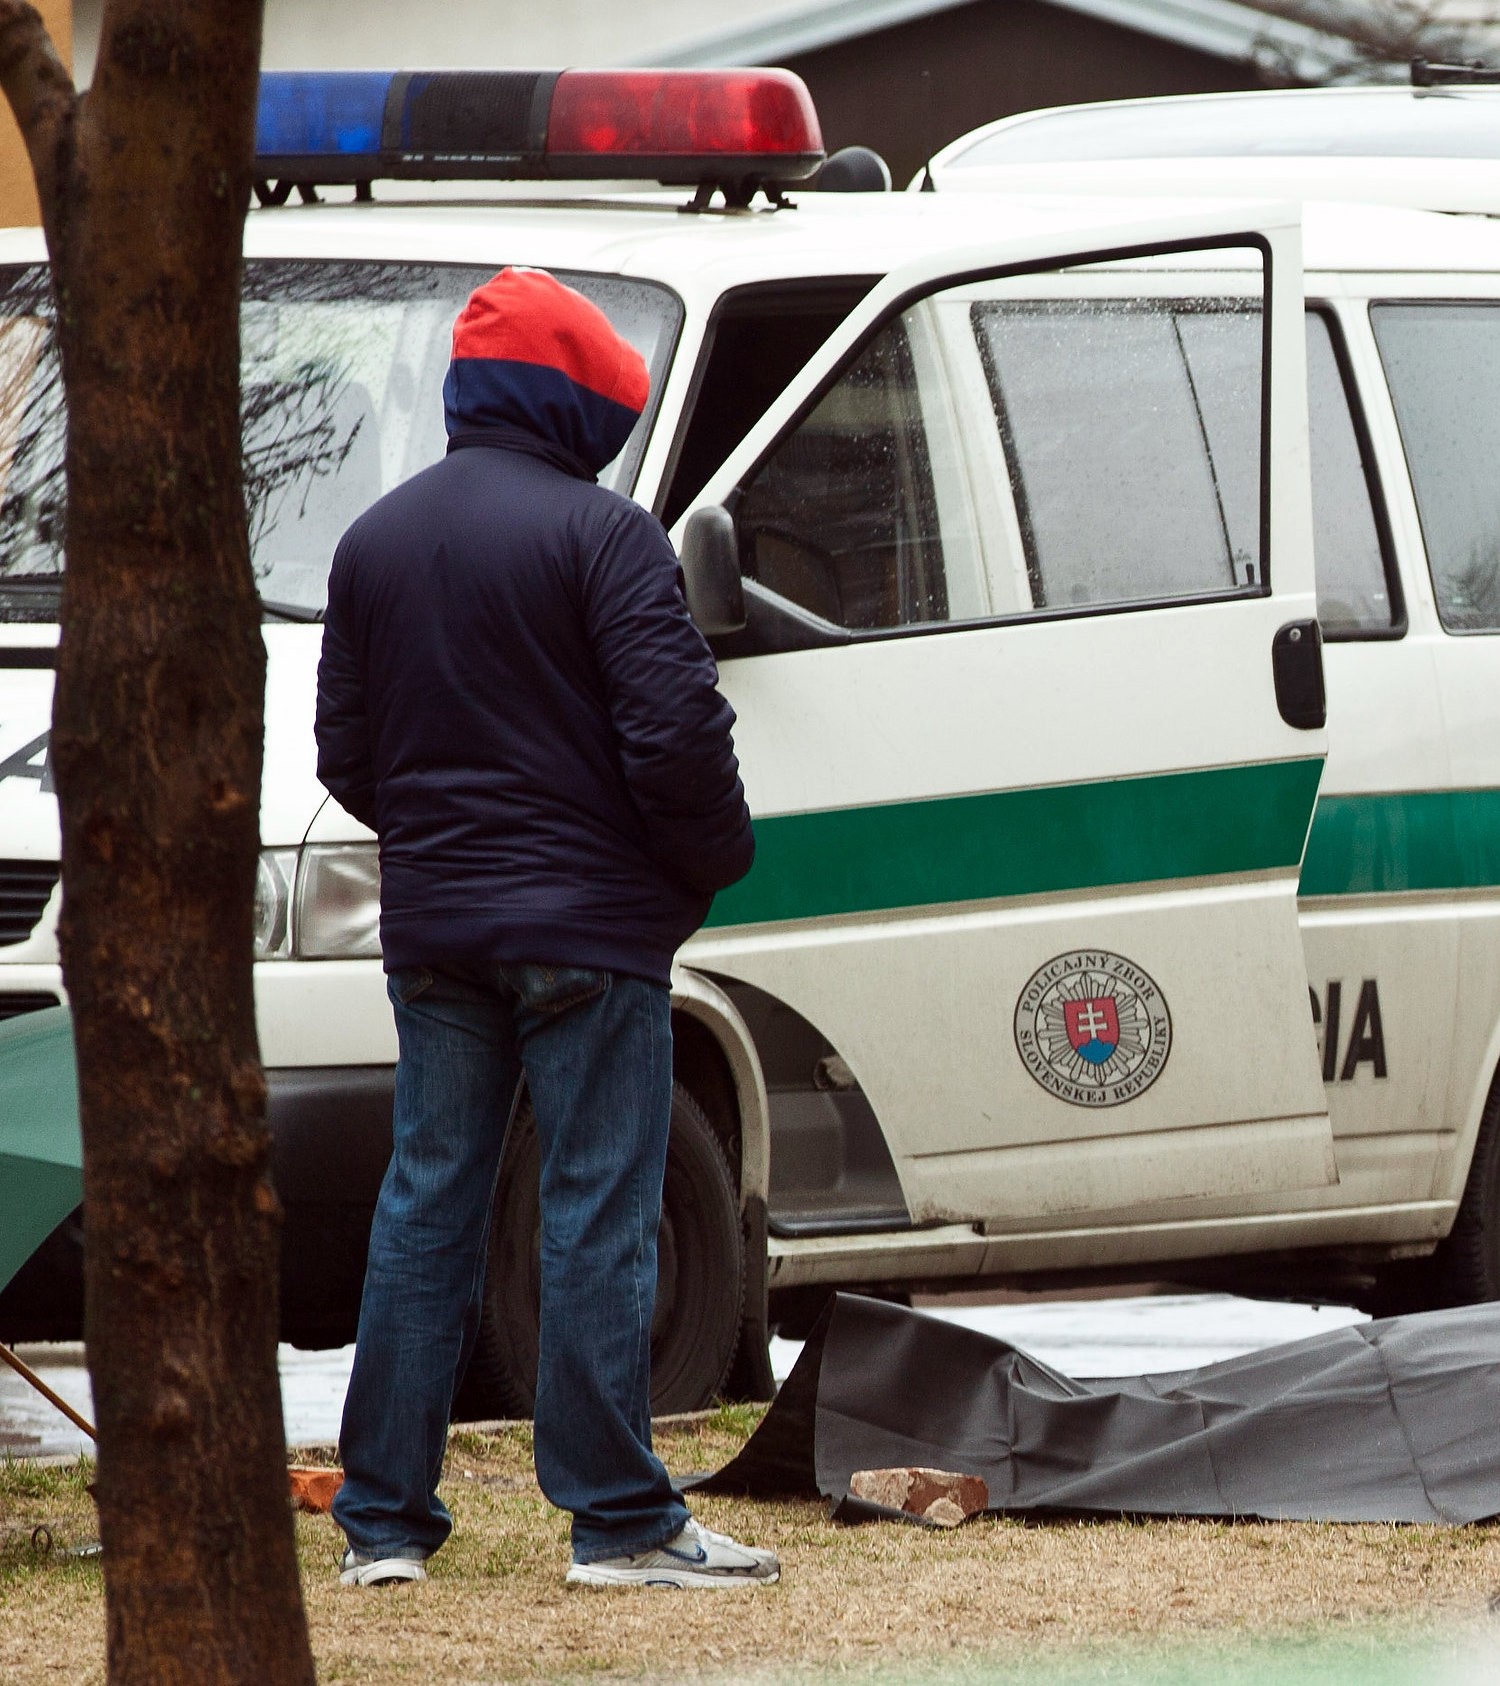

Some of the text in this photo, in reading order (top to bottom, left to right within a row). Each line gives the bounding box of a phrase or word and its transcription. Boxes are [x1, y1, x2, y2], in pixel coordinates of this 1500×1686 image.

[1113, 960, 1154, 1000] ZBOR
[1020, 1015, 1167, 1102] SLOVENSKEJ REPUBLIKY
[1308, 979, 1388, 1082] IA
